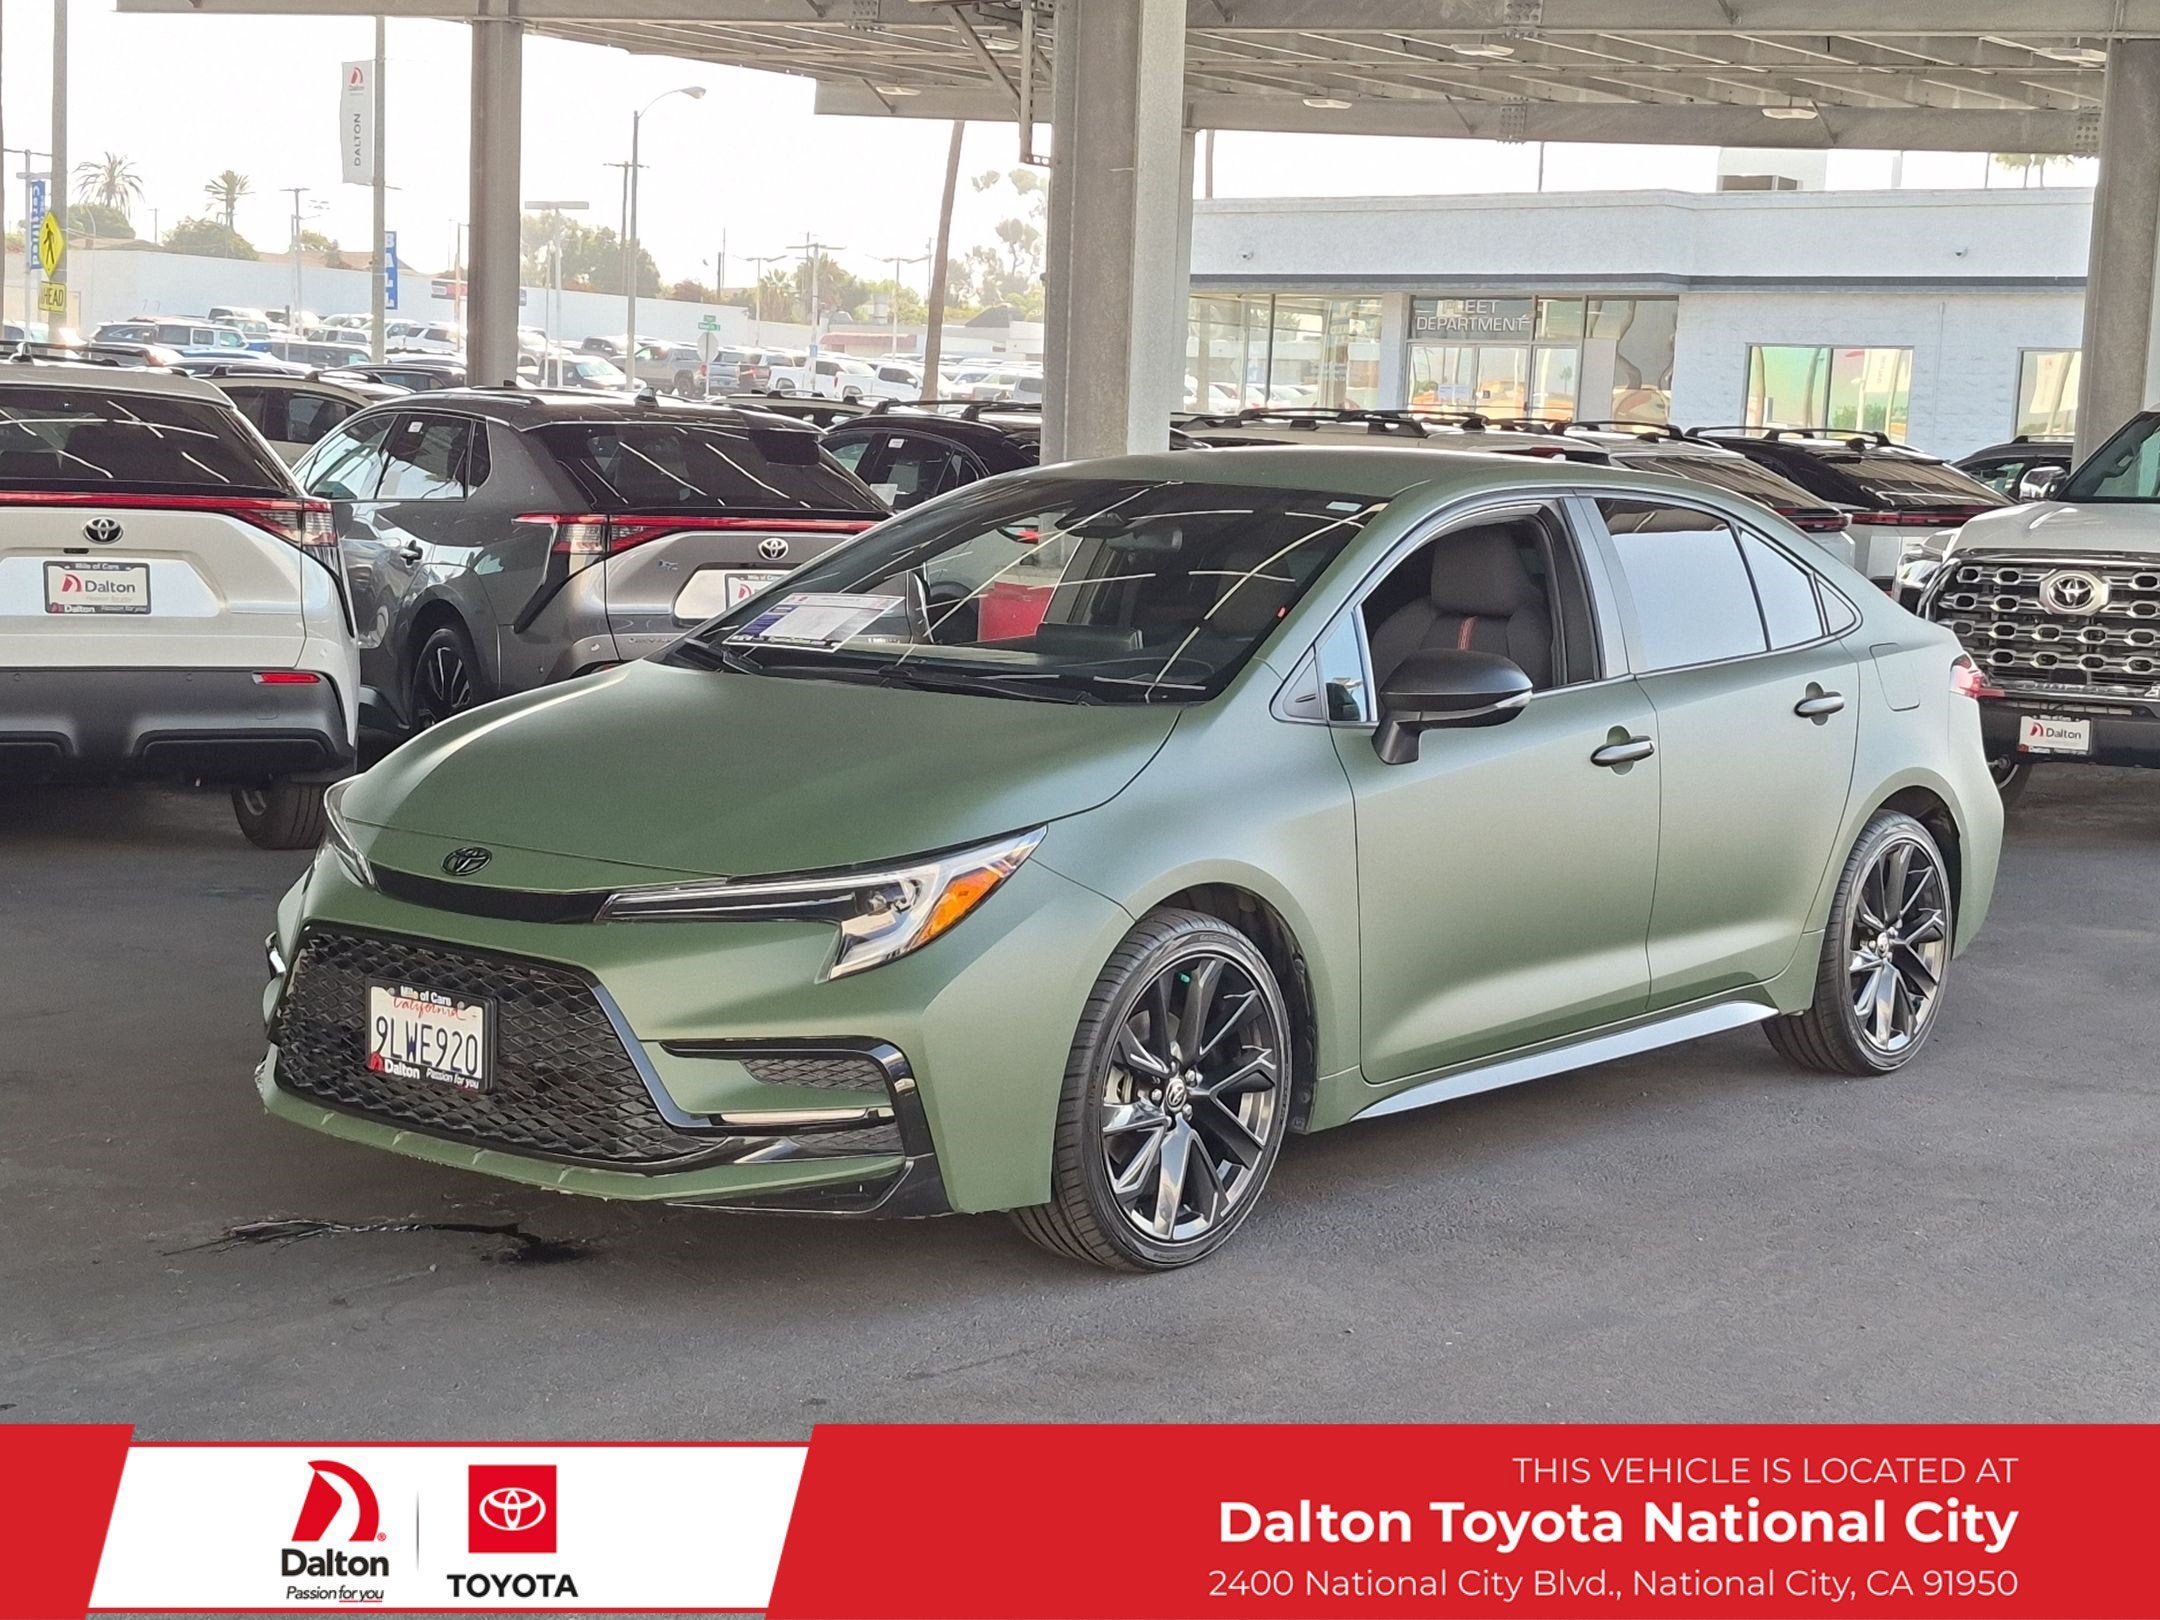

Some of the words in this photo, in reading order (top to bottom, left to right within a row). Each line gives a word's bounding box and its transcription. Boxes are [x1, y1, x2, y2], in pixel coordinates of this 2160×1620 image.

[353, 113, 361, 167] DALTON
[1416, 317, 1529, 331] DEPARTMENT
[85, 580, 136, 593] Dalton
[2046, 728, 2082, 740] Dalton
[400, 985, 419, 1000] Mile
[420, 990, 430, 1001] of
[430, 991, 452, 1007] Cars
[375, 1016, 478, 1076] 9LWE920
[384, 1058, 421, 1080] Dalton
[425, 1067, 453, 1083] Passion
[453, 1070, 465, 1086] for
[465, 1077, 480, 1090] you
